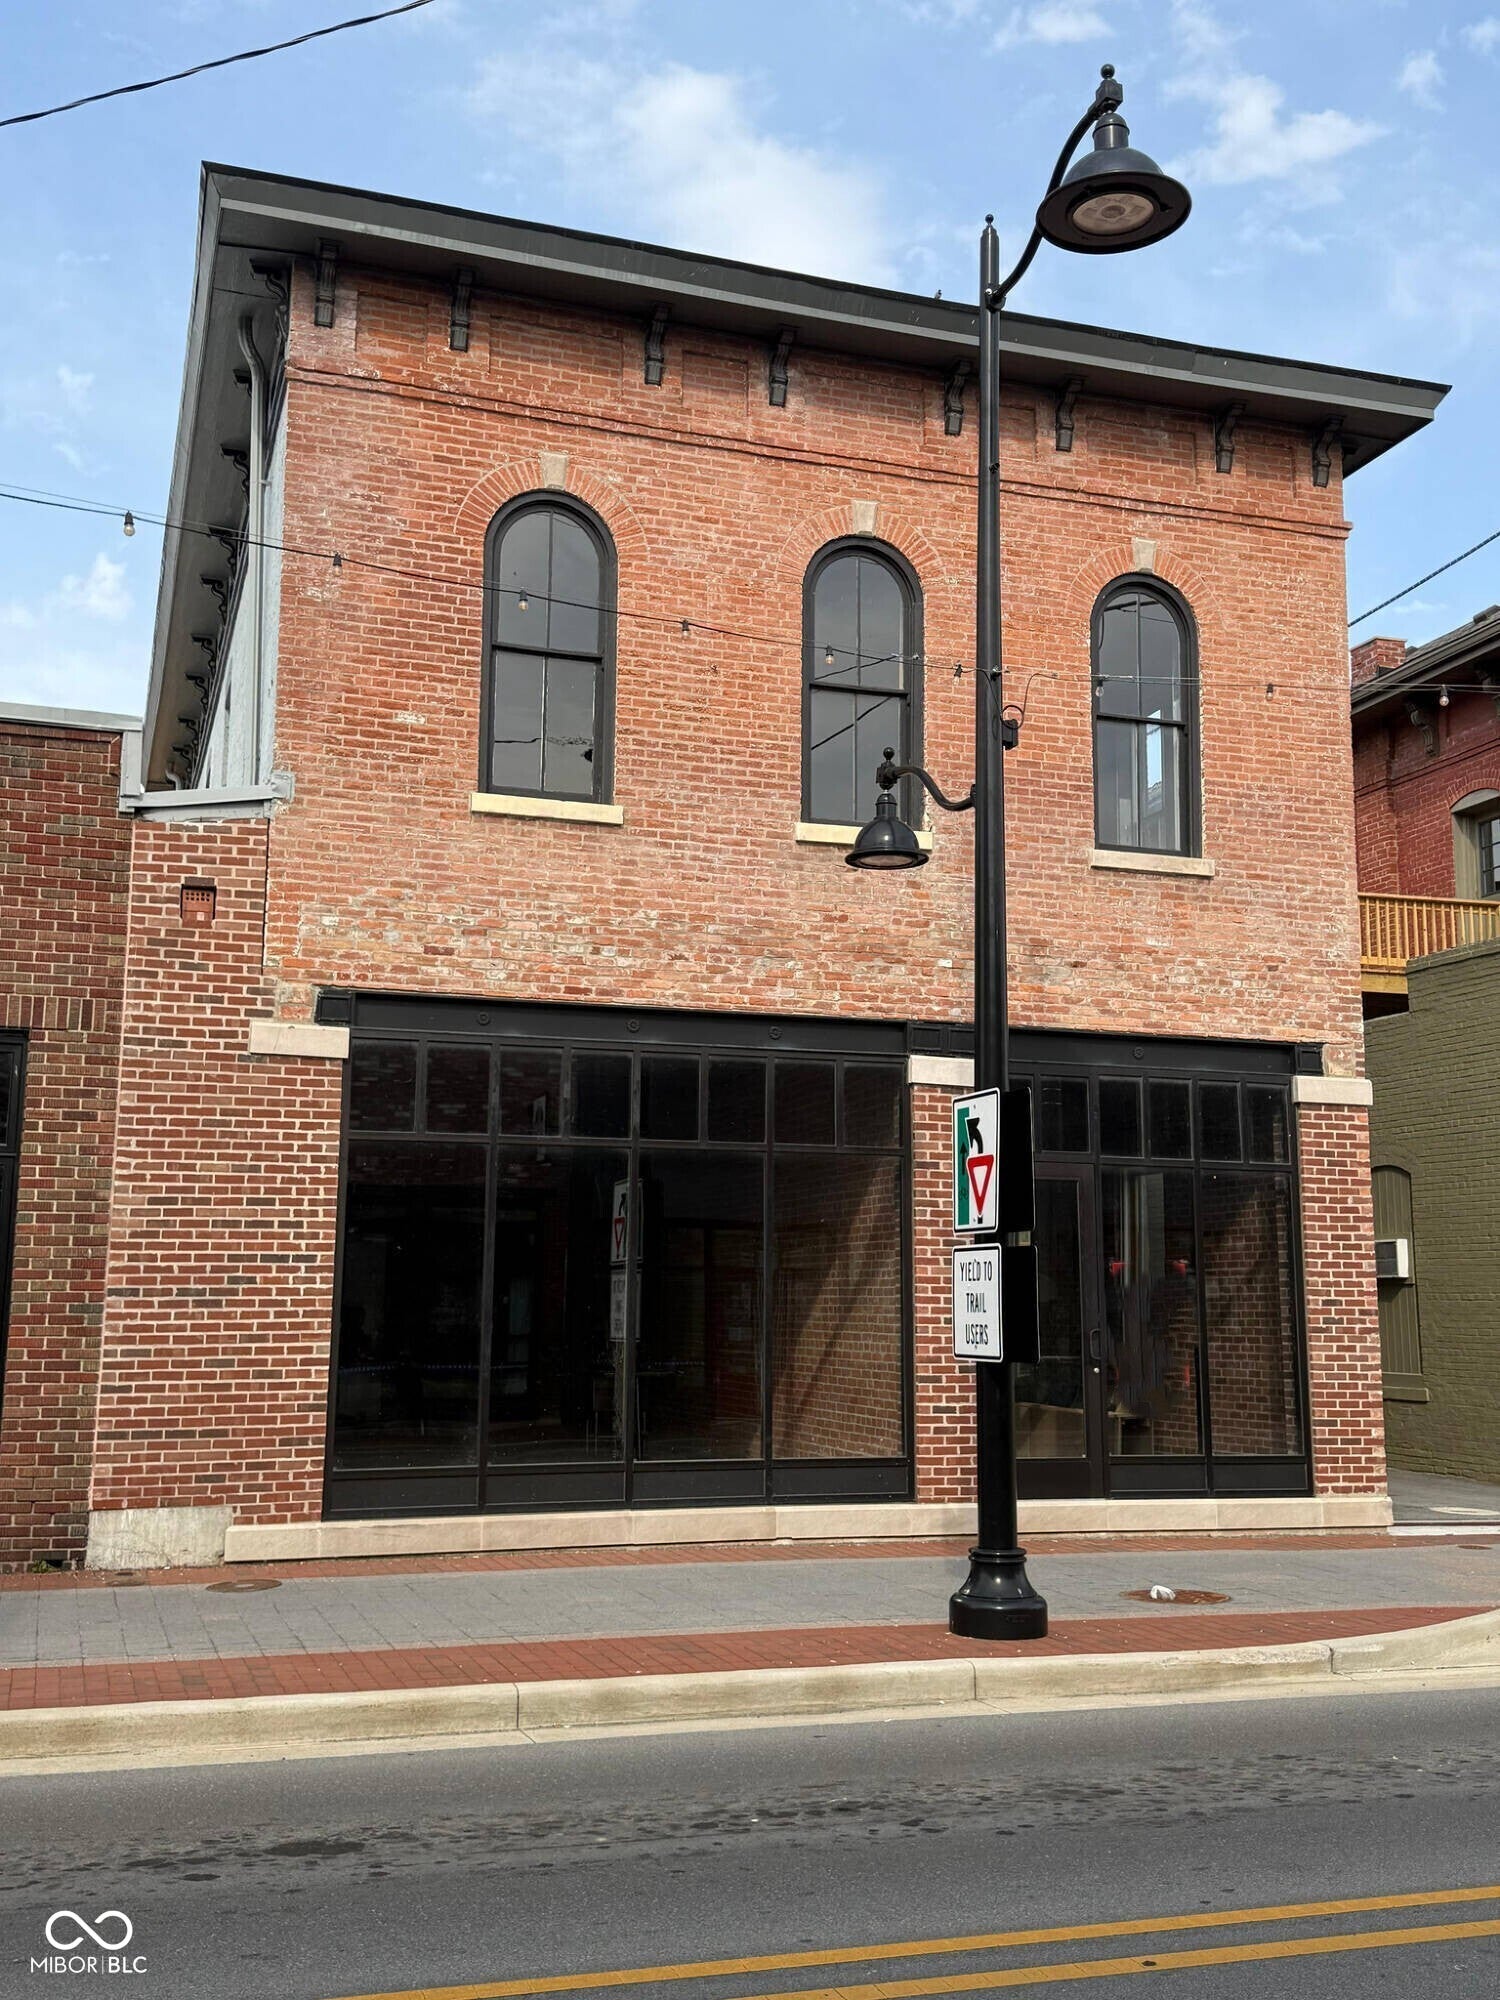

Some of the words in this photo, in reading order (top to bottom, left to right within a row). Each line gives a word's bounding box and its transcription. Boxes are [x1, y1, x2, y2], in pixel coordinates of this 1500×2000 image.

[960, 1262, 981, 1281] YIELD
[984, 1261, 992, 1281] TO
[966, 1293, 986, 1312] TRAIL
[965, 1324, 988, 1345] USERS
